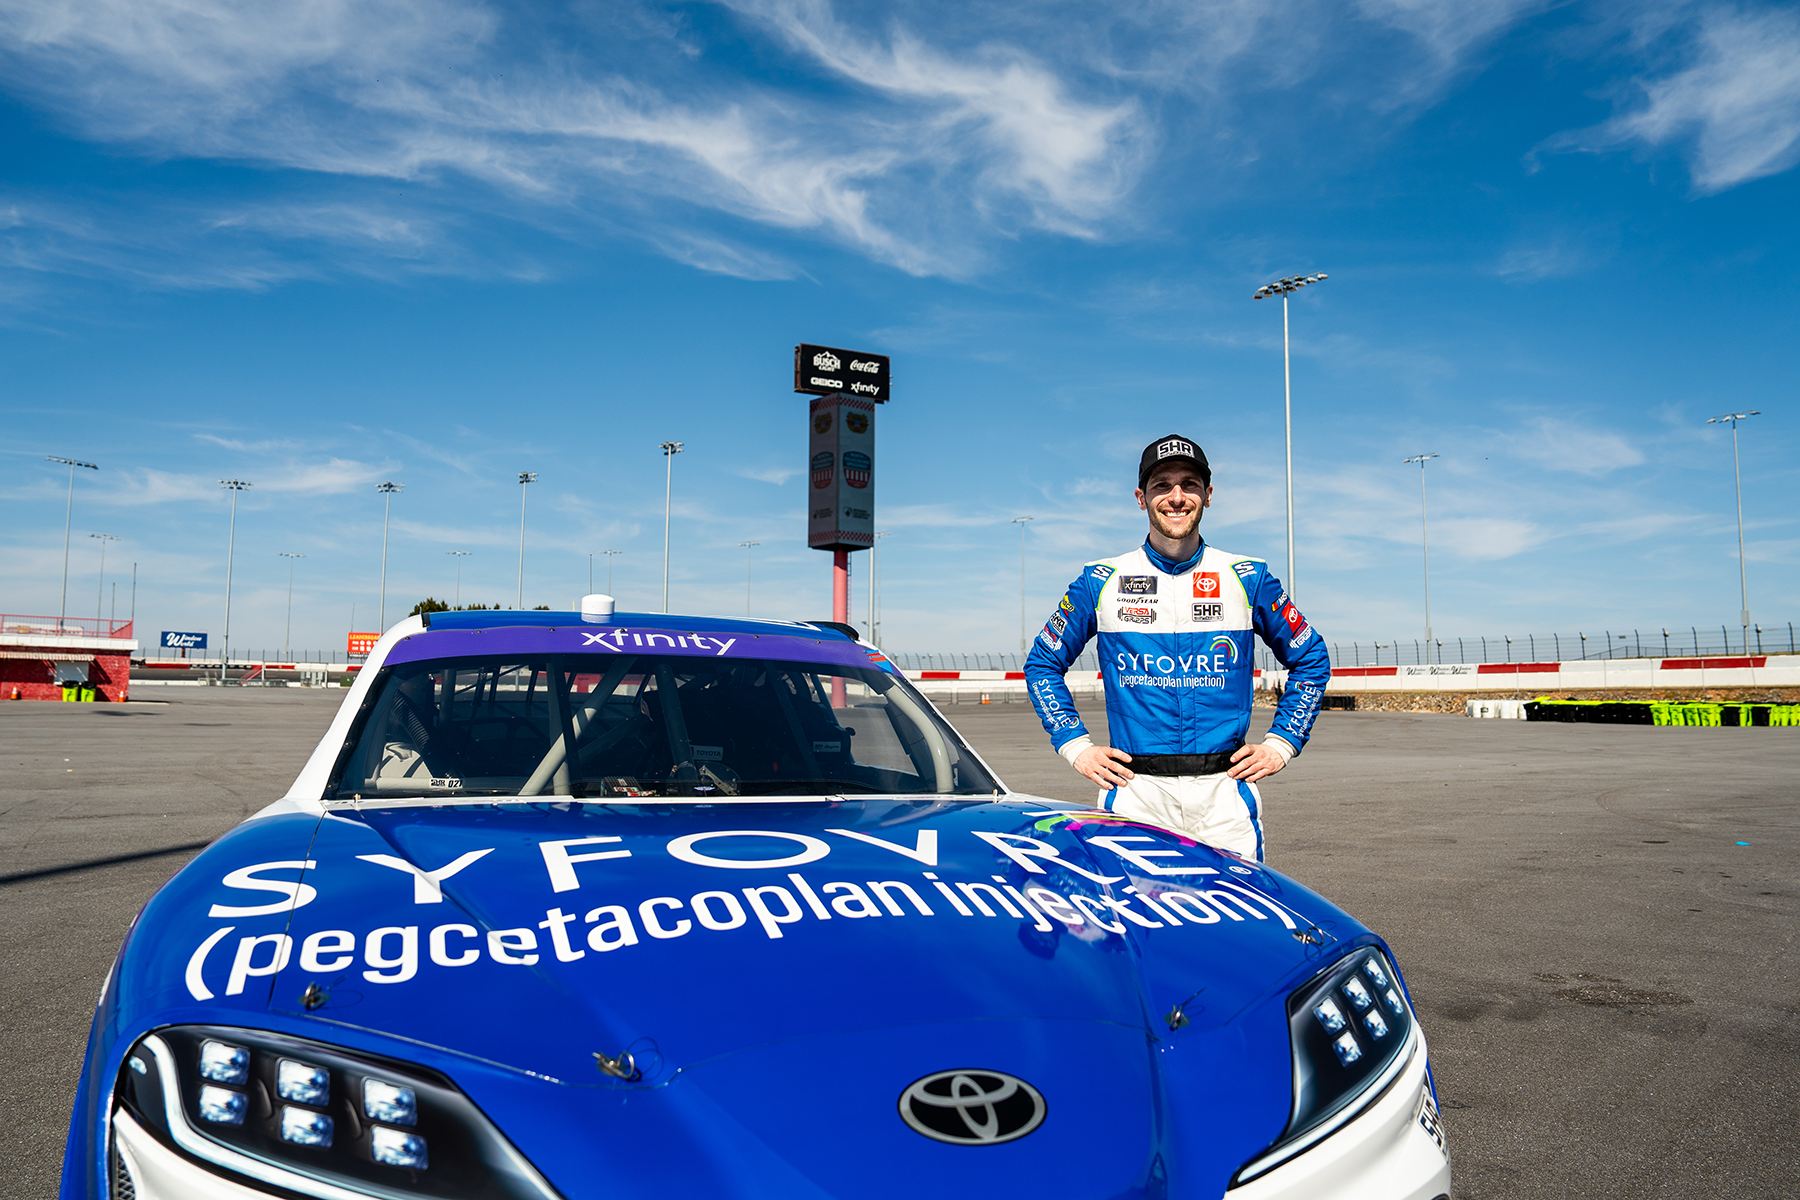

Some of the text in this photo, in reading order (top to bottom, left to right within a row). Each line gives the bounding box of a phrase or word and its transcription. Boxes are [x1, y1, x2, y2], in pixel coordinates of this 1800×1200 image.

[813, 355, 841, 370] BUSCH
[811, 377, 843, 389] GEICO
[851, 381, 880, 396] xfinity
[1159, 441, 1192, 455] SHR
[1125, 581, 1151, 591] xfinity
[1116, 596, 1159, 605] GOODYEAR
[1124, 606, 1150, 616] VERSA
[1193, 604, 1221, 616] SHR
[580, 628, 737, 656] xfinity
[1117, 653, 1226, 674] SYFOVRE
[1119, 673, 1226, 690] (pegcetacoplan injection)
[208, 829, 1219, 918] SYFOVRE
[185, 872, 1298, 1002] (pegcetacoplan injection)
